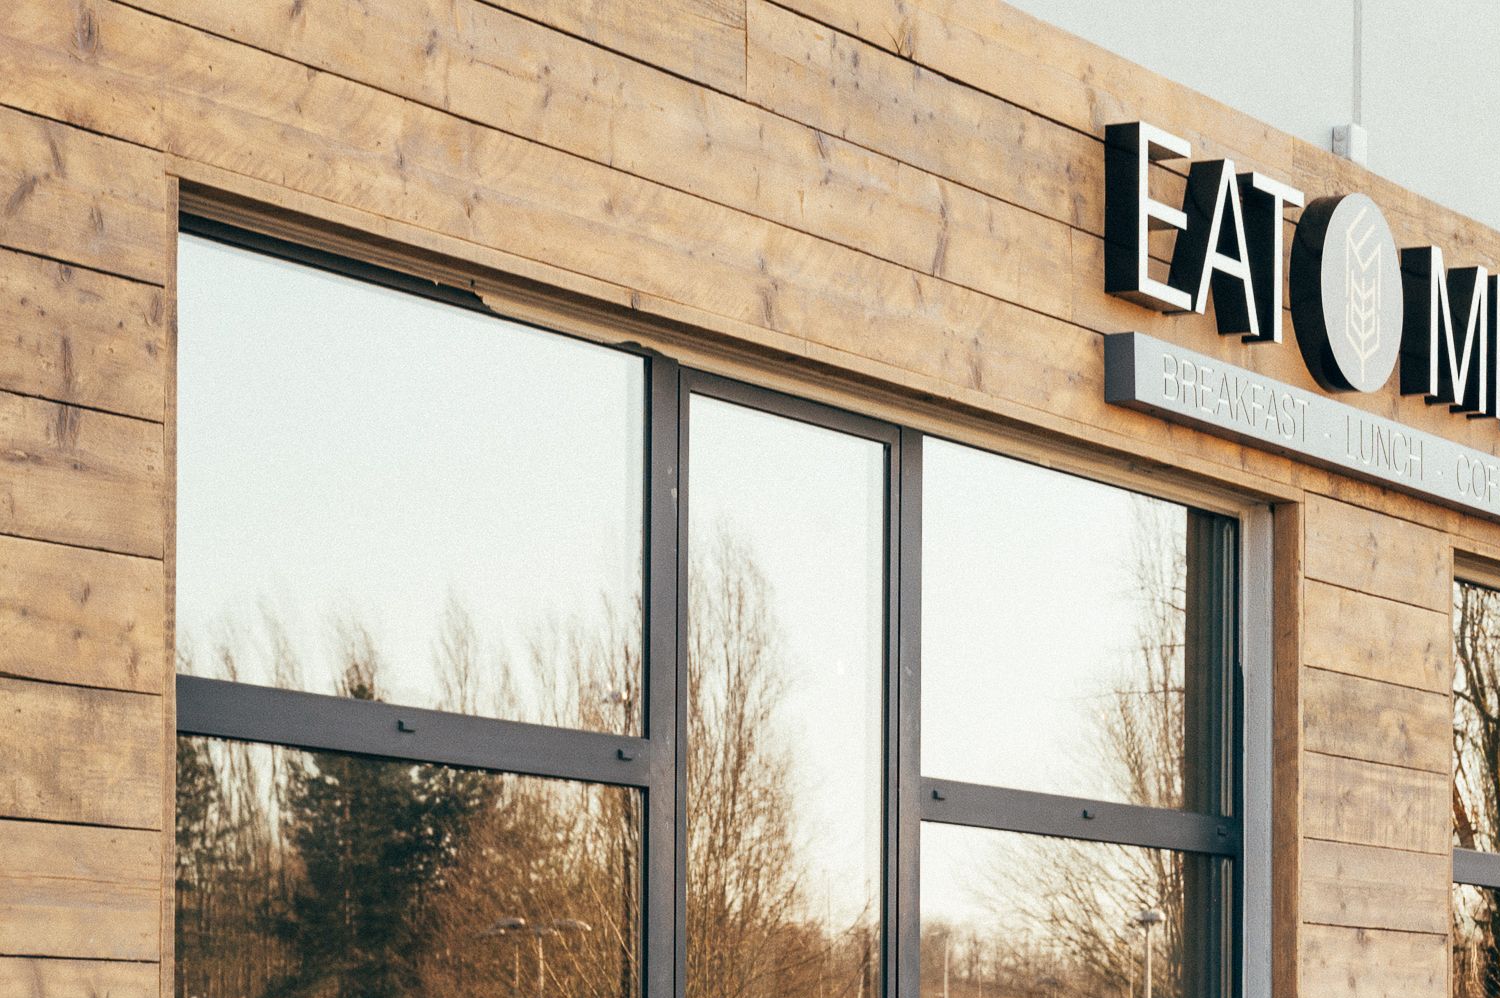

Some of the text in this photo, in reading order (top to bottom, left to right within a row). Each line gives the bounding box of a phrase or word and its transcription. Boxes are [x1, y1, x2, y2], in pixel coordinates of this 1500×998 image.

[1138, 120, 1305, 344] EAT
[1162, 353, 1311, 443] BREAKFAST
[1345, 415, 1423, 481] LUNCH
